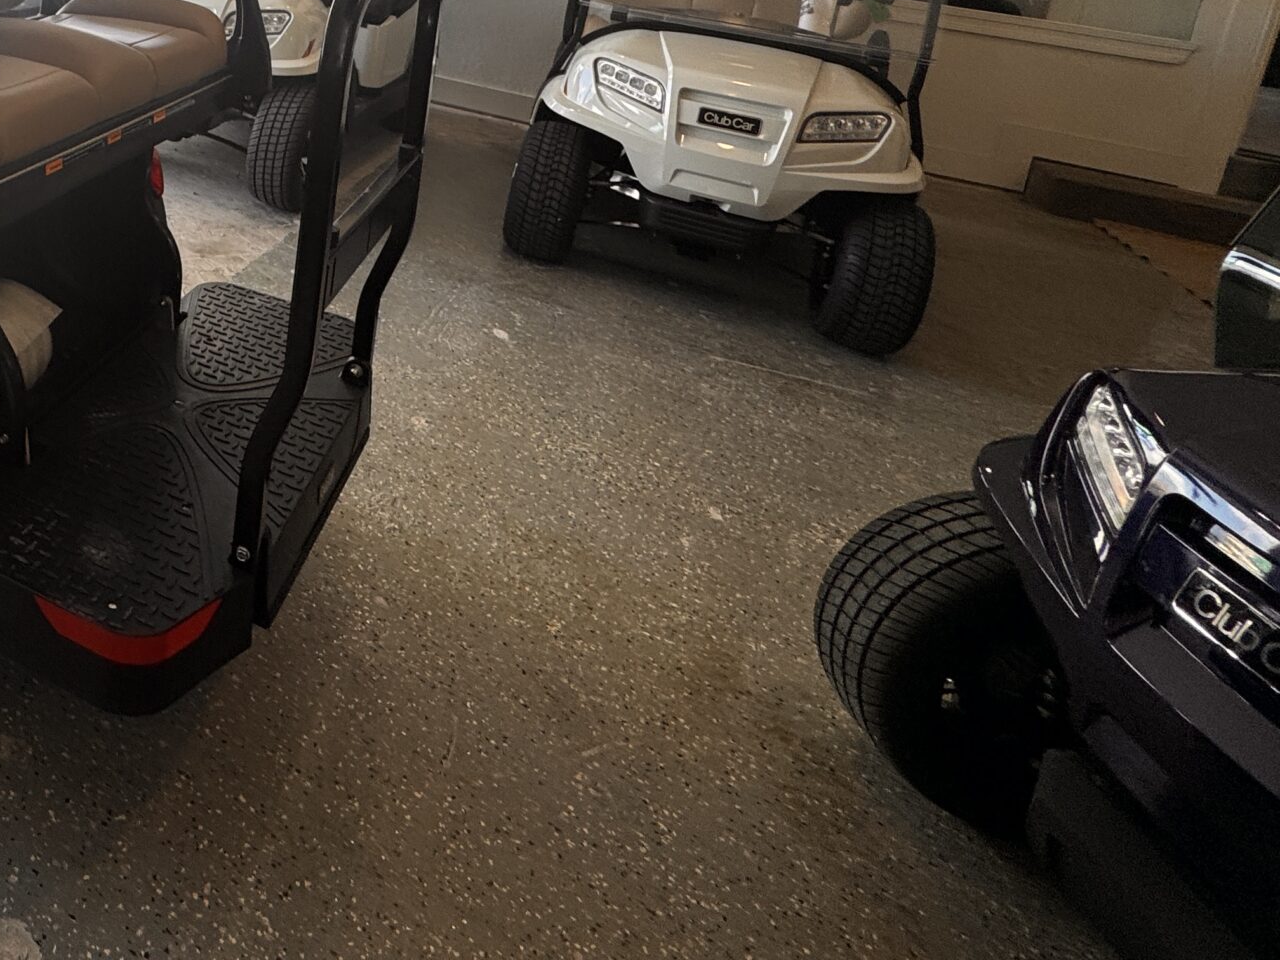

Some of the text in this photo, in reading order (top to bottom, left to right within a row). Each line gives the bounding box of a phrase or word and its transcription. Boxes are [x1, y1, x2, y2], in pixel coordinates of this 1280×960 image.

[704, 111, 756, 131] Club Car
[1194, 588, 1260, 652] Club
